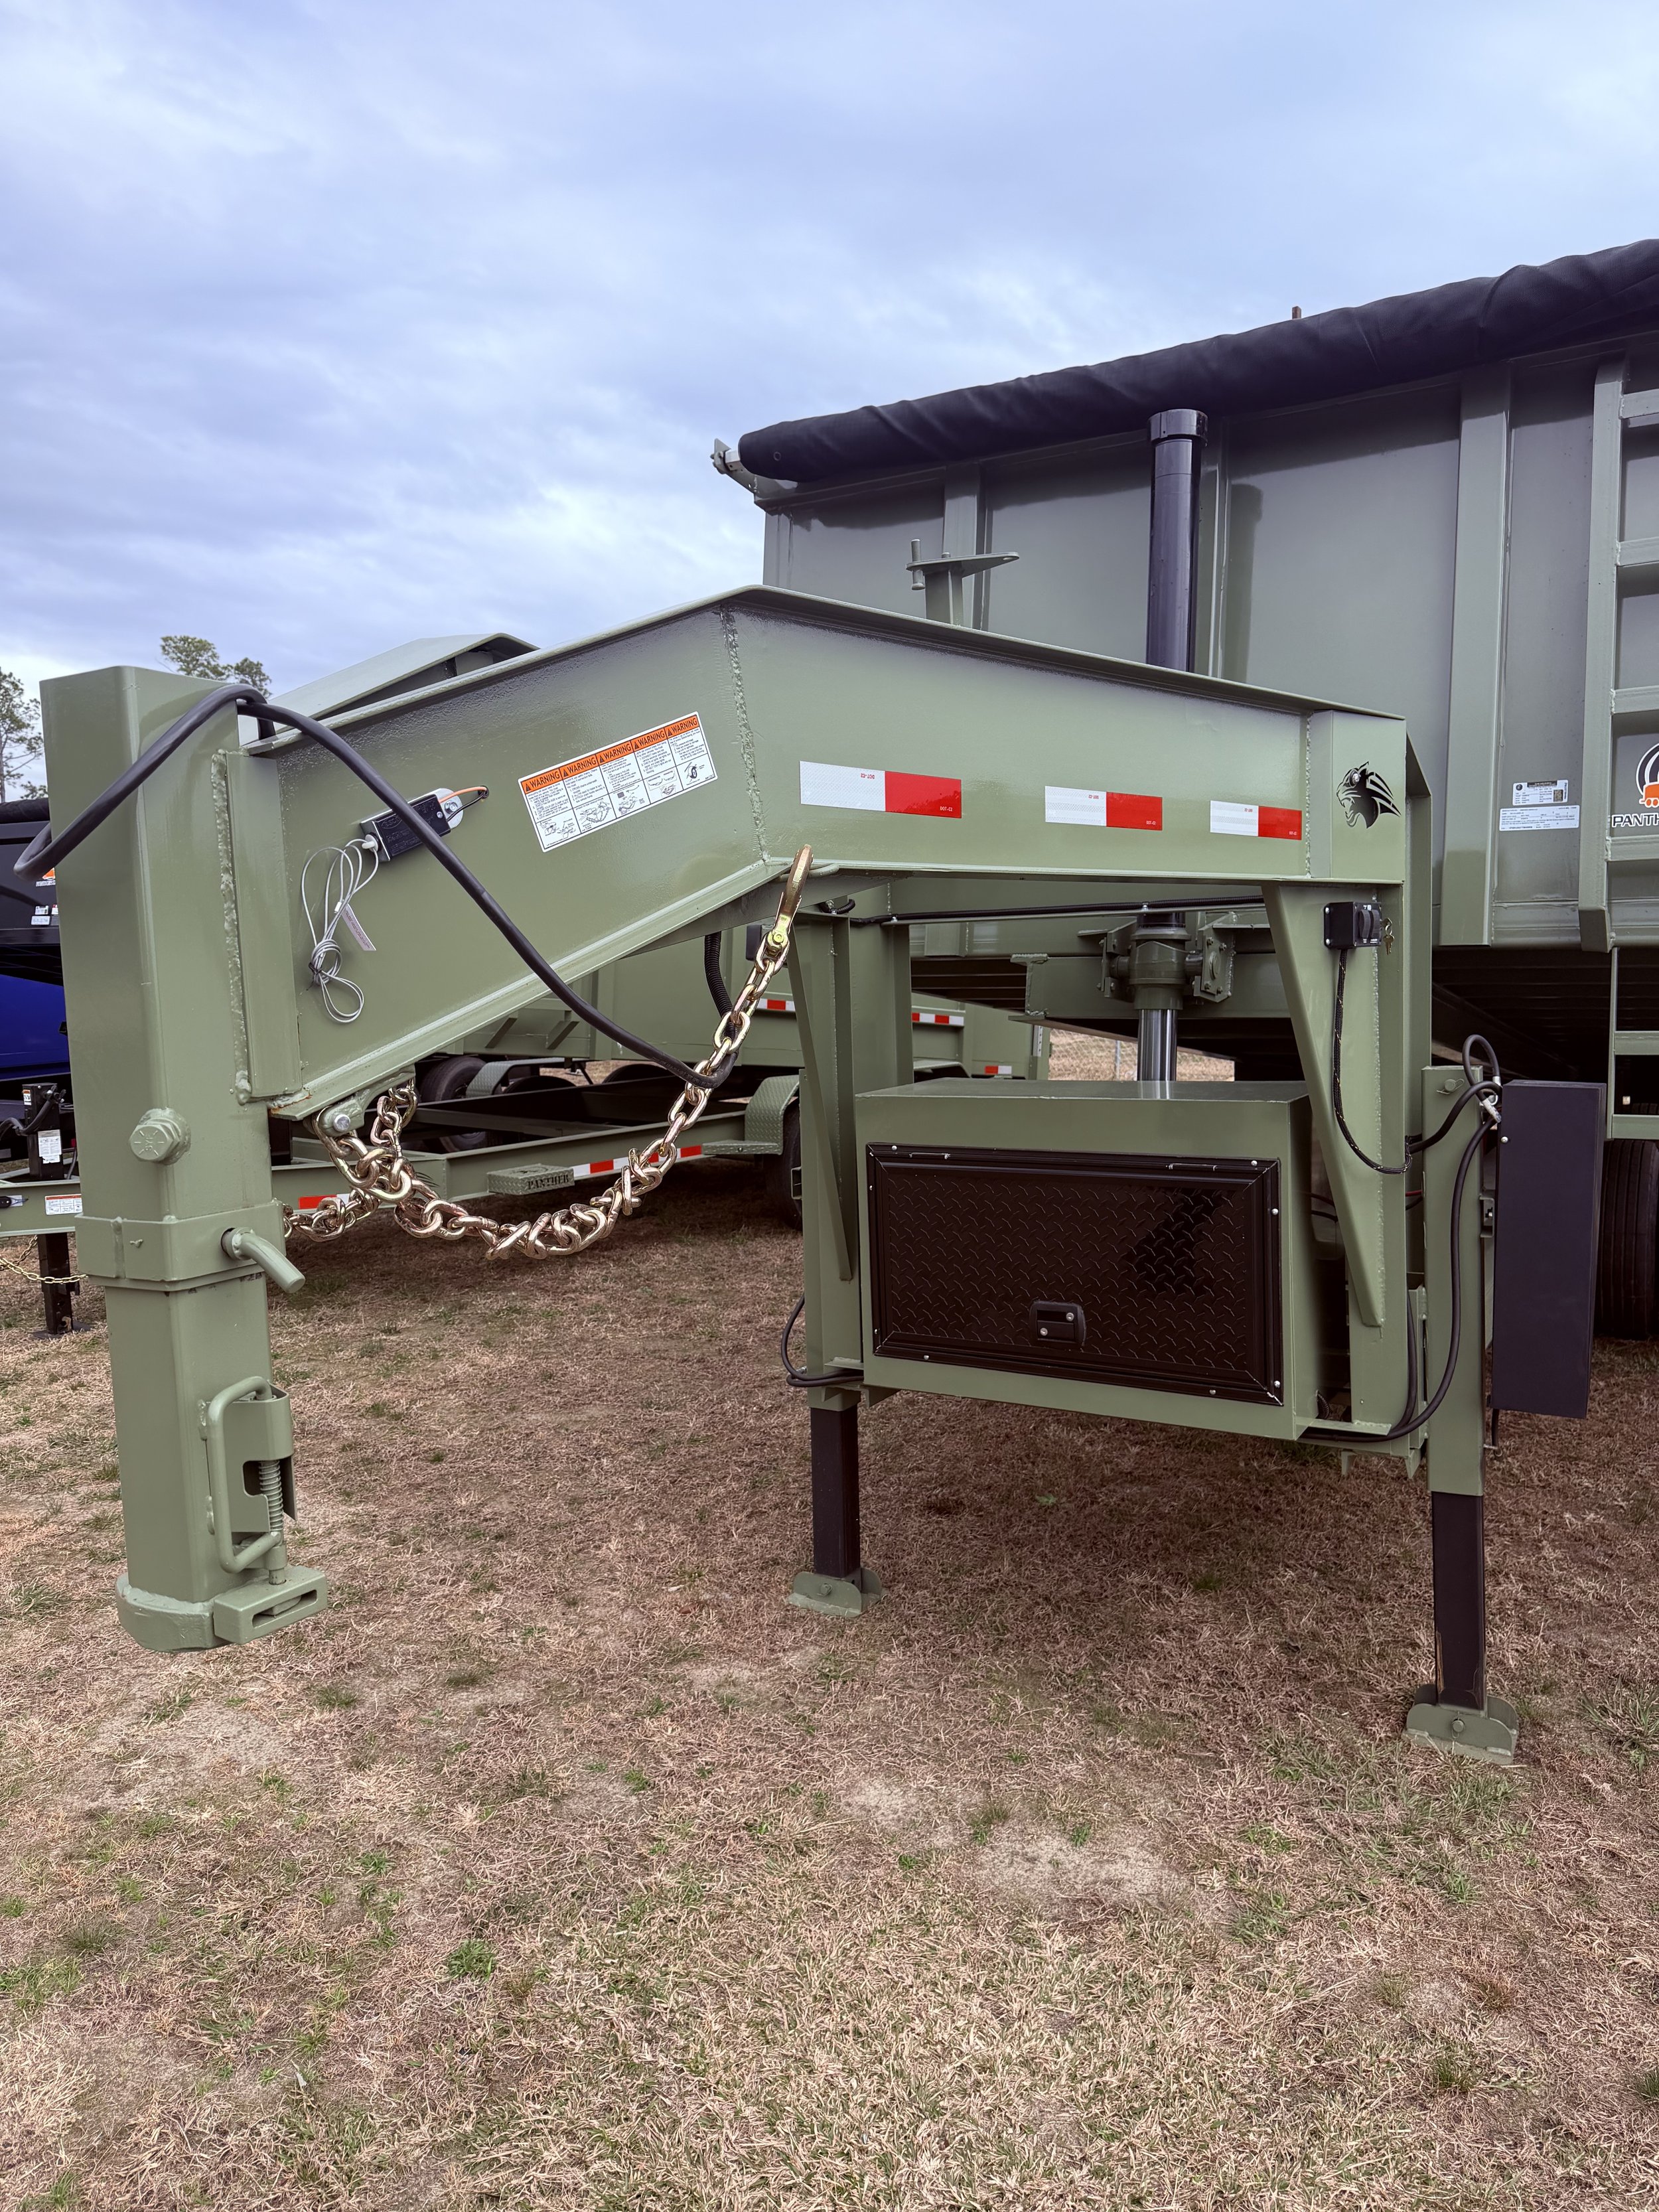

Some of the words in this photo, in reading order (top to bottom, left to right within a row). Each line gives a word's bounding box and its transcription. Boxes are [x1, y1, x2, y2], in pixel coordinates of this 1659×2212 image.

[670, 717, 697, 734] WARNING
[636, 729, 665, 747] WARNING
[603, 743, 631, 760] WARNING
[567, 756, 596, 774] WARNING
[530, 770, 559, 788] WARNING
[528, 1174, 569, 1190] PANTHER
